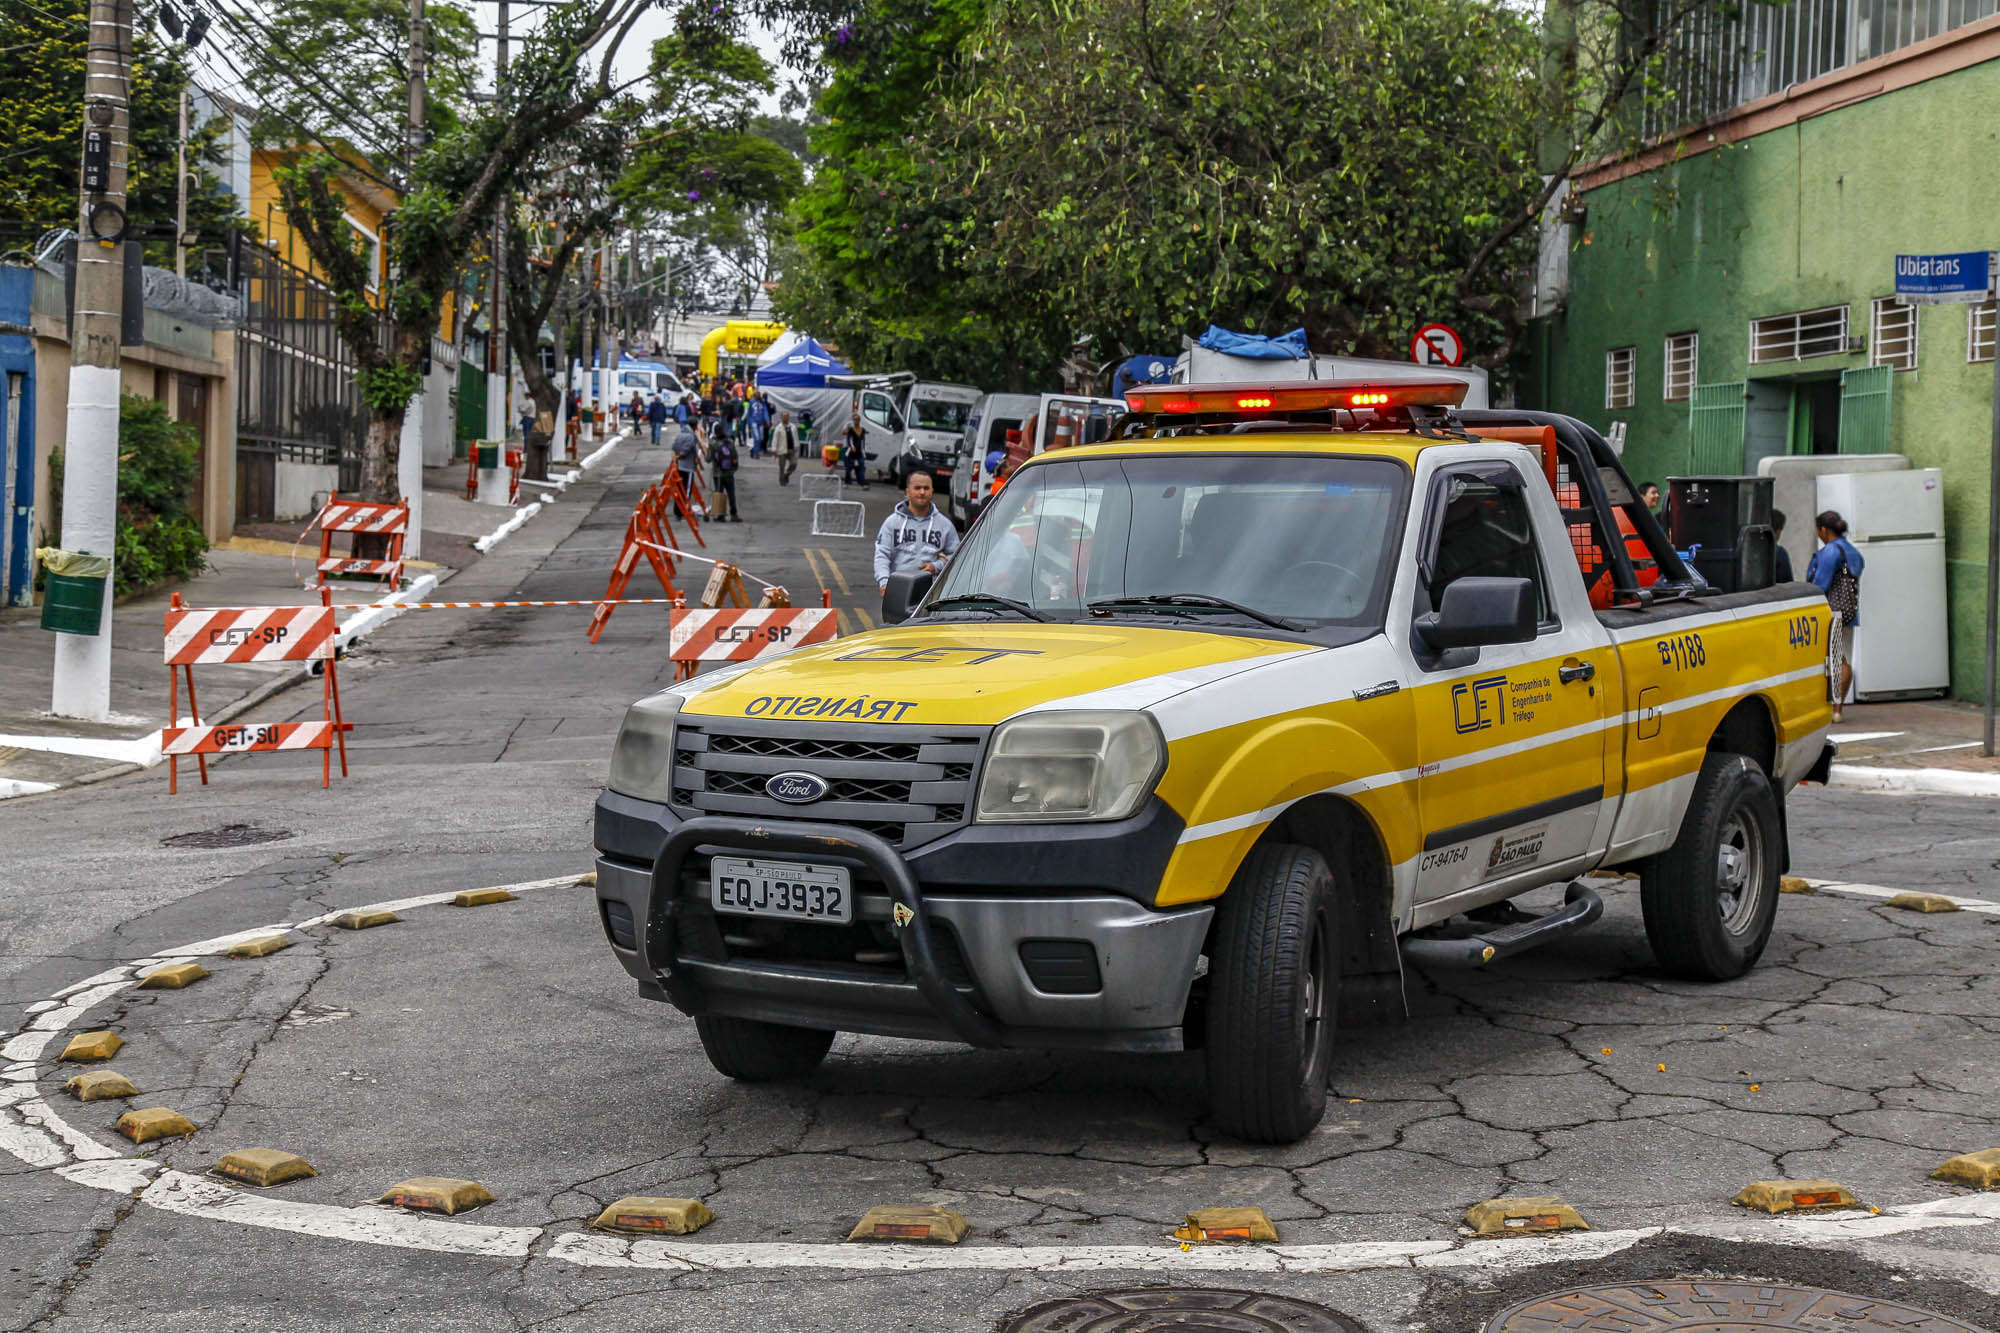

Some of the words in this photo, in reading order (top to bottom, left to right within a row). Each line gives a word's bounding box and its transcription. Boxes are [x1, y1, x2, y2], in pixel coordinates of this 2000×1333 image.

[1898, 256, 1960, 276] Ubiatans
[210, 626, 288, 646] CET-SP
[715, 626, 792, 643] CET-SP
[1789, 616, 1819, 649] 4497
[833, 646, 1046, 665] CET
[1670, 633, 1706, 671] 1188
[1510, 679, 1542, 692] Companhia
[1543, 677, 1551, 687] de
[1452, 675, 1508, 734] CET
[1512, 694, 1544, 708] Engenharia
[1545, 691, 1552, 701] de
[1513, 711, 1534, 723] Tráfego
[778, 777, 811, 797] Ford
[1421, 846, 1469, 871] CT-9476-0
[1500, 848, 1517, 864] SÃO
[1516, 840, 1542, 859] PAULO
